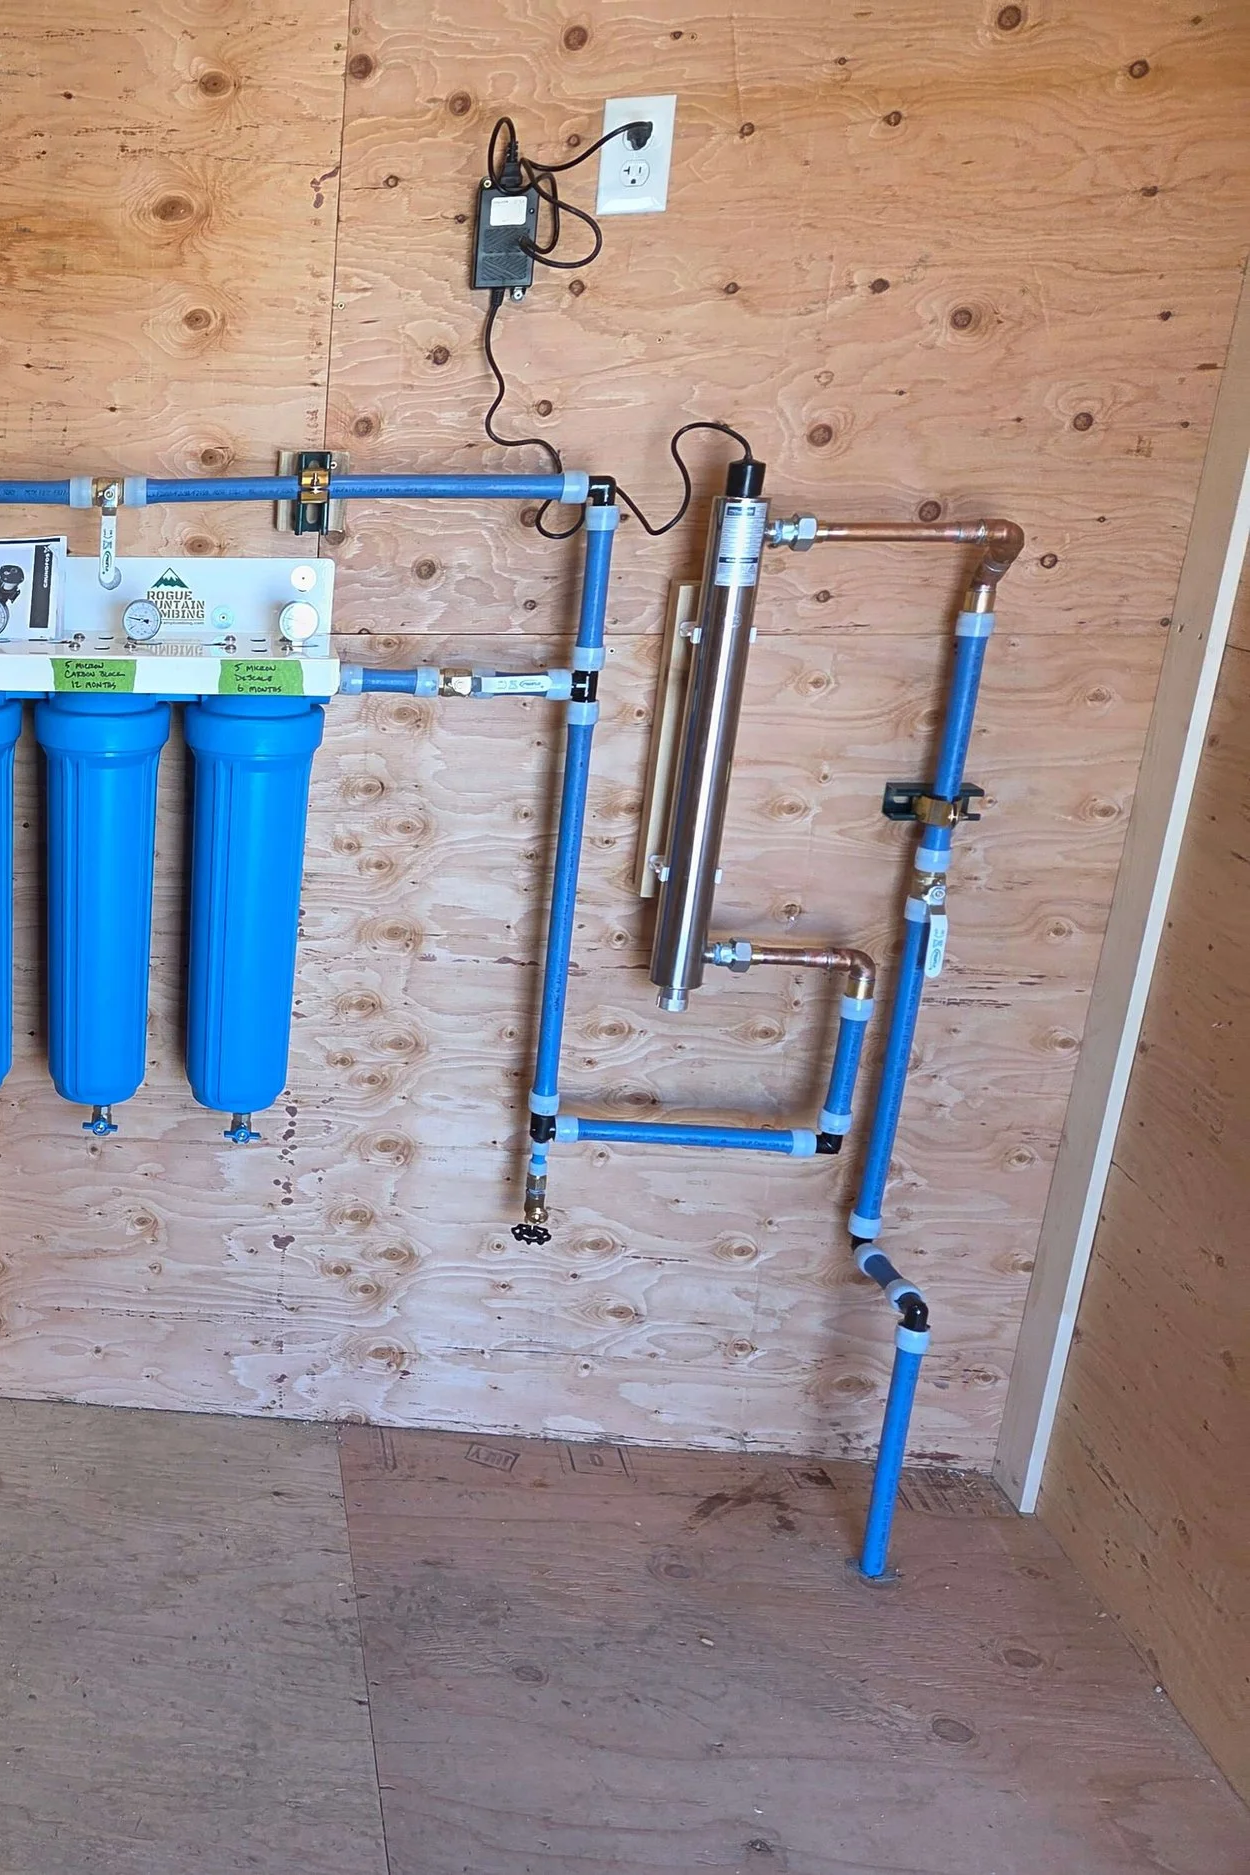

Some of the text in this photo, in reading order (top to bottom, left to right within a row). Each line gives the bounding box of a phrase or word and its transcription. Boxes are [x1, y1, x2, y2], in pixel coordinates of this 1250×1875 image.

[147, 591, 192, 600] ROGUE
[154, 601, 205, 609] UNTAIN
[161, 610, 205, 618] MBING
[65, 661, 72, 669] 5
[234, 663, 243, 671] 5
[64, 670, 95, 678] CARBON
[237, 684, 244, 692] 6
